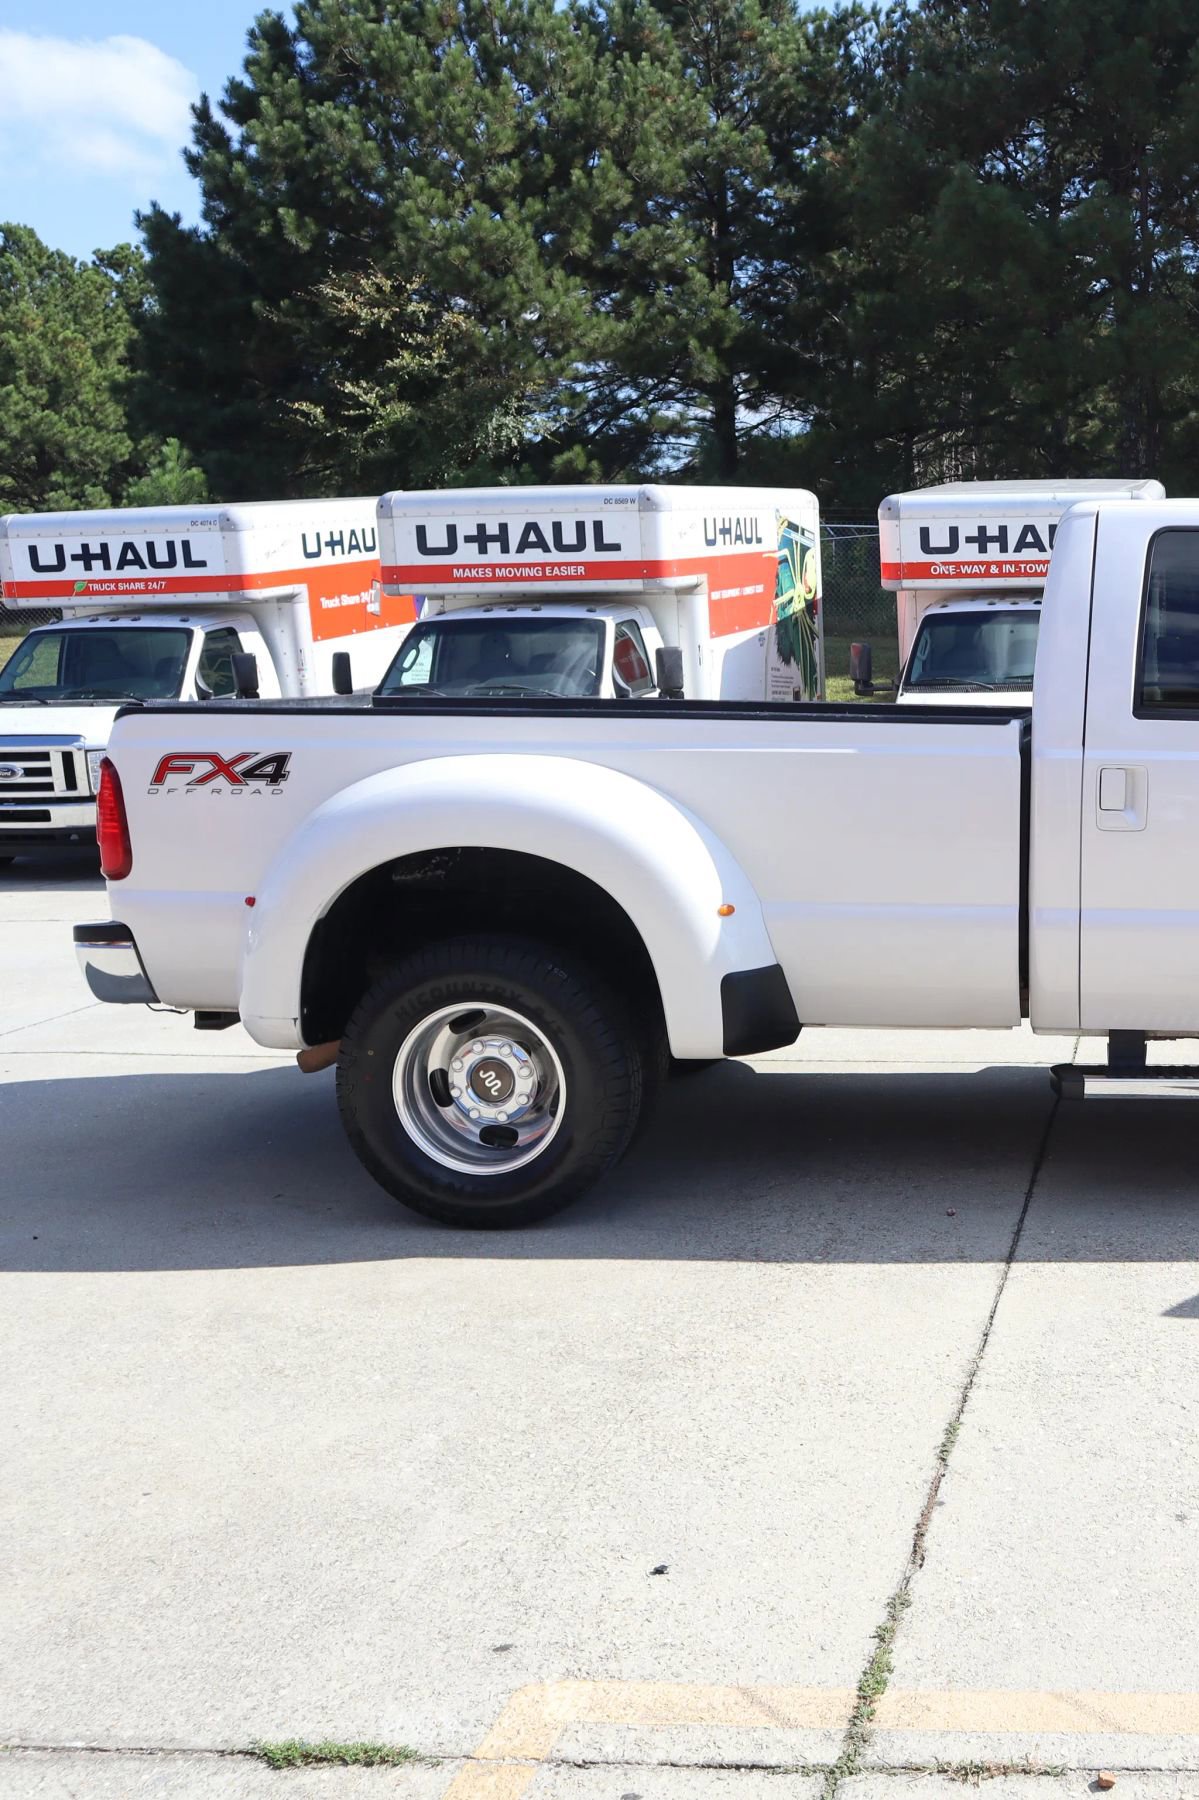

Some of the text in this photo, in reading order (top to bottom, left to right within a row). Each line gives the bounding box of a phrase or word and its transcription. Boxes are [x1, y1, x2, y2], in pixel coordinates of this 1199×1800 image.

[301, 527, 377, 559] U-HAU
[415, 519, 622, 556] U-HAUL
[703, 517, 763, 547] U-HAUL
[28, 539, 208, 573] U-HAUL
[930, 564, 986, 575] ONE-WAY
[989, 564, 1000, 574] &
[88, 581, 167, 592] TRUCK SHARE 24/7
[452, 564, 586, 579] MAKES MOVING EASIER
[320, 594, 342, 609] Truck
[340, 594, 361, 607] Share
[360, 588, 377, 605] 24/7
[150, 751, 293, 786] FX4
